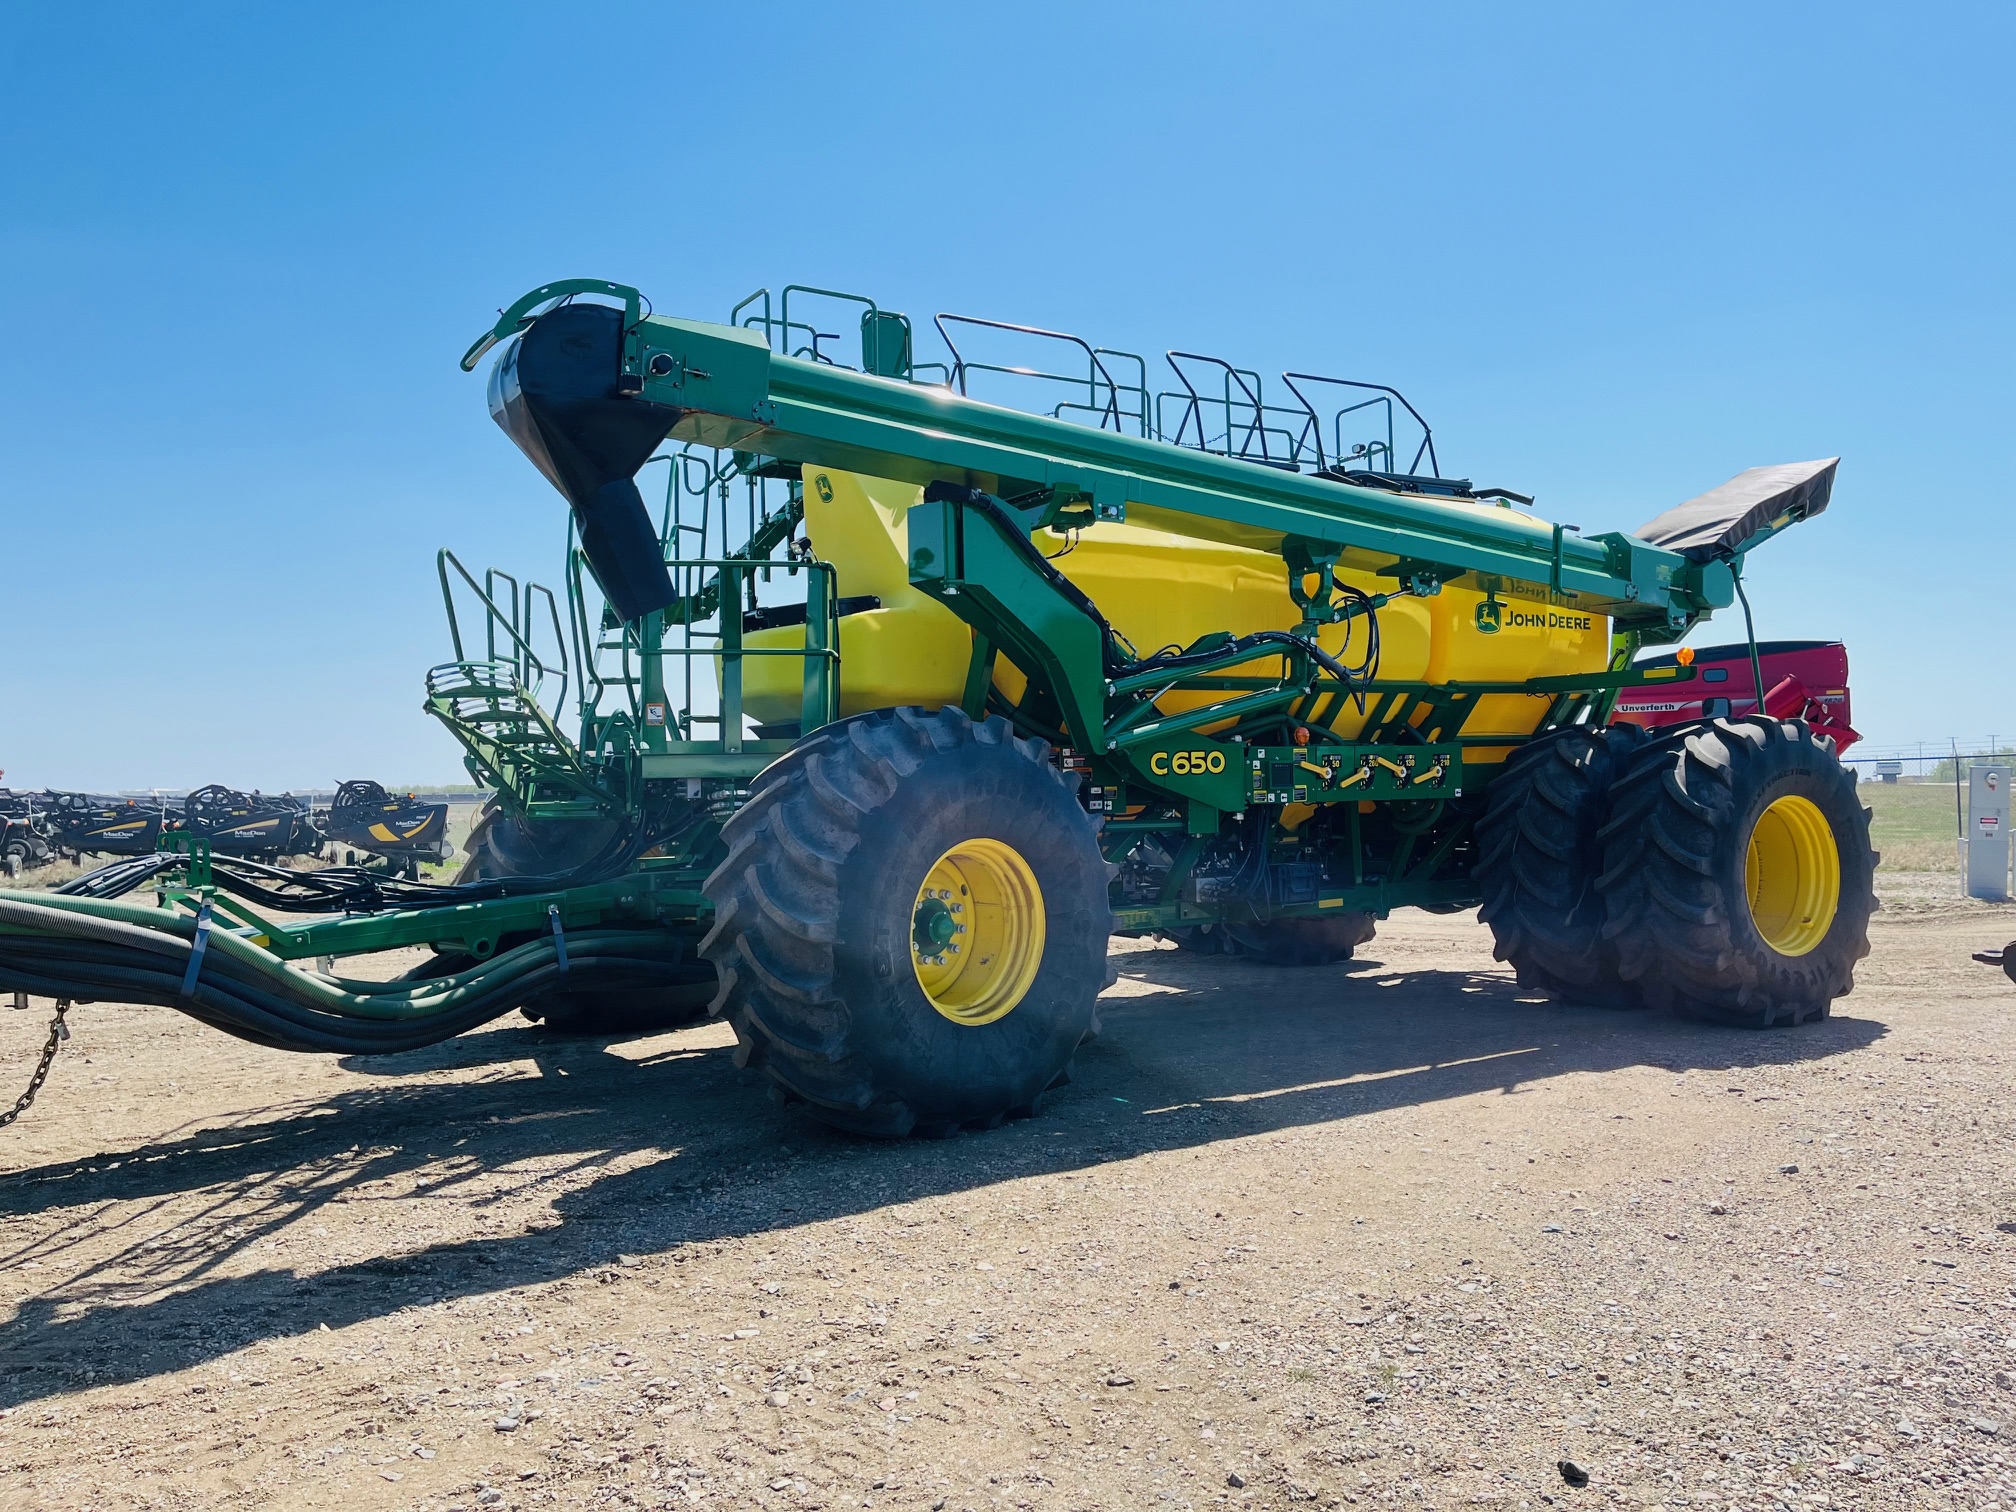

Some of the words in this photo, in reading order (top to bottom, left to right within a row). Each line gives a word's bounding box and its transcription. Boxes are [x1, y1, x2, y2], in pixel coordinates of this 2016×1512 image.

[1505, 610, 1546, 627] JOHN
[1548, 612, 1592, 630] DEERE
[1621, 703, 1675, 712] Unverferth
